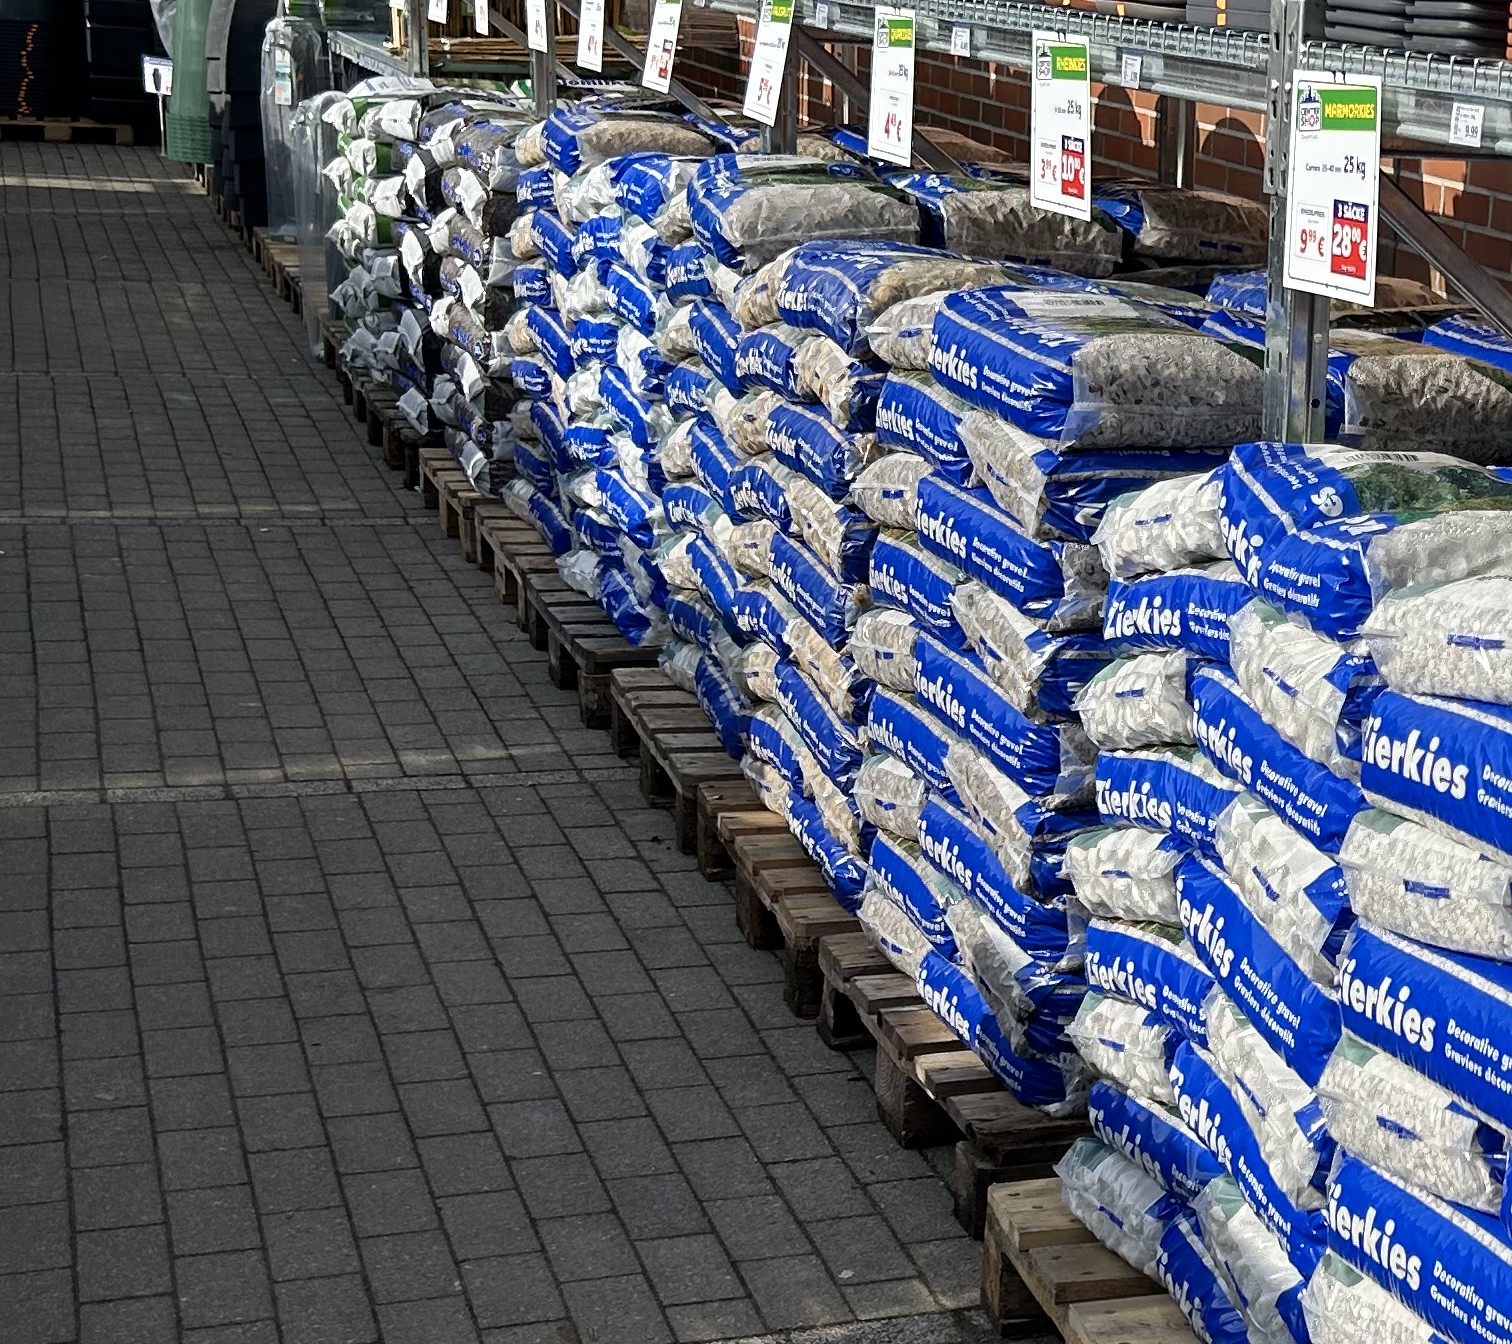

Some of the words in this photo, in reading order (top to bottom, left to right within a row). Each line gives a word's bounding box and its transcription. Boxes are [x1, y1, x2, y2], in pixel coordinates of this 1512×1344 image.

[1300, 116, 1320, 128] SHOP
[1324, 103, 1375, 120] MARMORKIES
[1343, 155, 1354, 174] 25
[1356, 158, 1366, 180] kg
[1318, 236, 1325, 257] €
[1359, 244, 1367, 262] €
[1103, 595, 1183, 641] Zierkies
[1095, 778, 1173, 830] Zierkies
[1260, 758, 1300, 798] Decorative
[1296, 785, 1330, 820] gravel
[1086, 950, 1159, 1011] Zierkies
[1239, 956, 1279, 1006] Decorative
[1275, 1000, 1302, 1031] gravel
[1233, 974, 1261, 1014] Graviers
[1260, 1005, 1297, 1050] décoratifs
[1444, 1041, 1484, 1077] Graviers
[1446, 1017, 1500, 1062] Decorative
[1430, 1284, 1469, 1325] Graviers
[1432, 1259, 1485, 1312] Decorative
